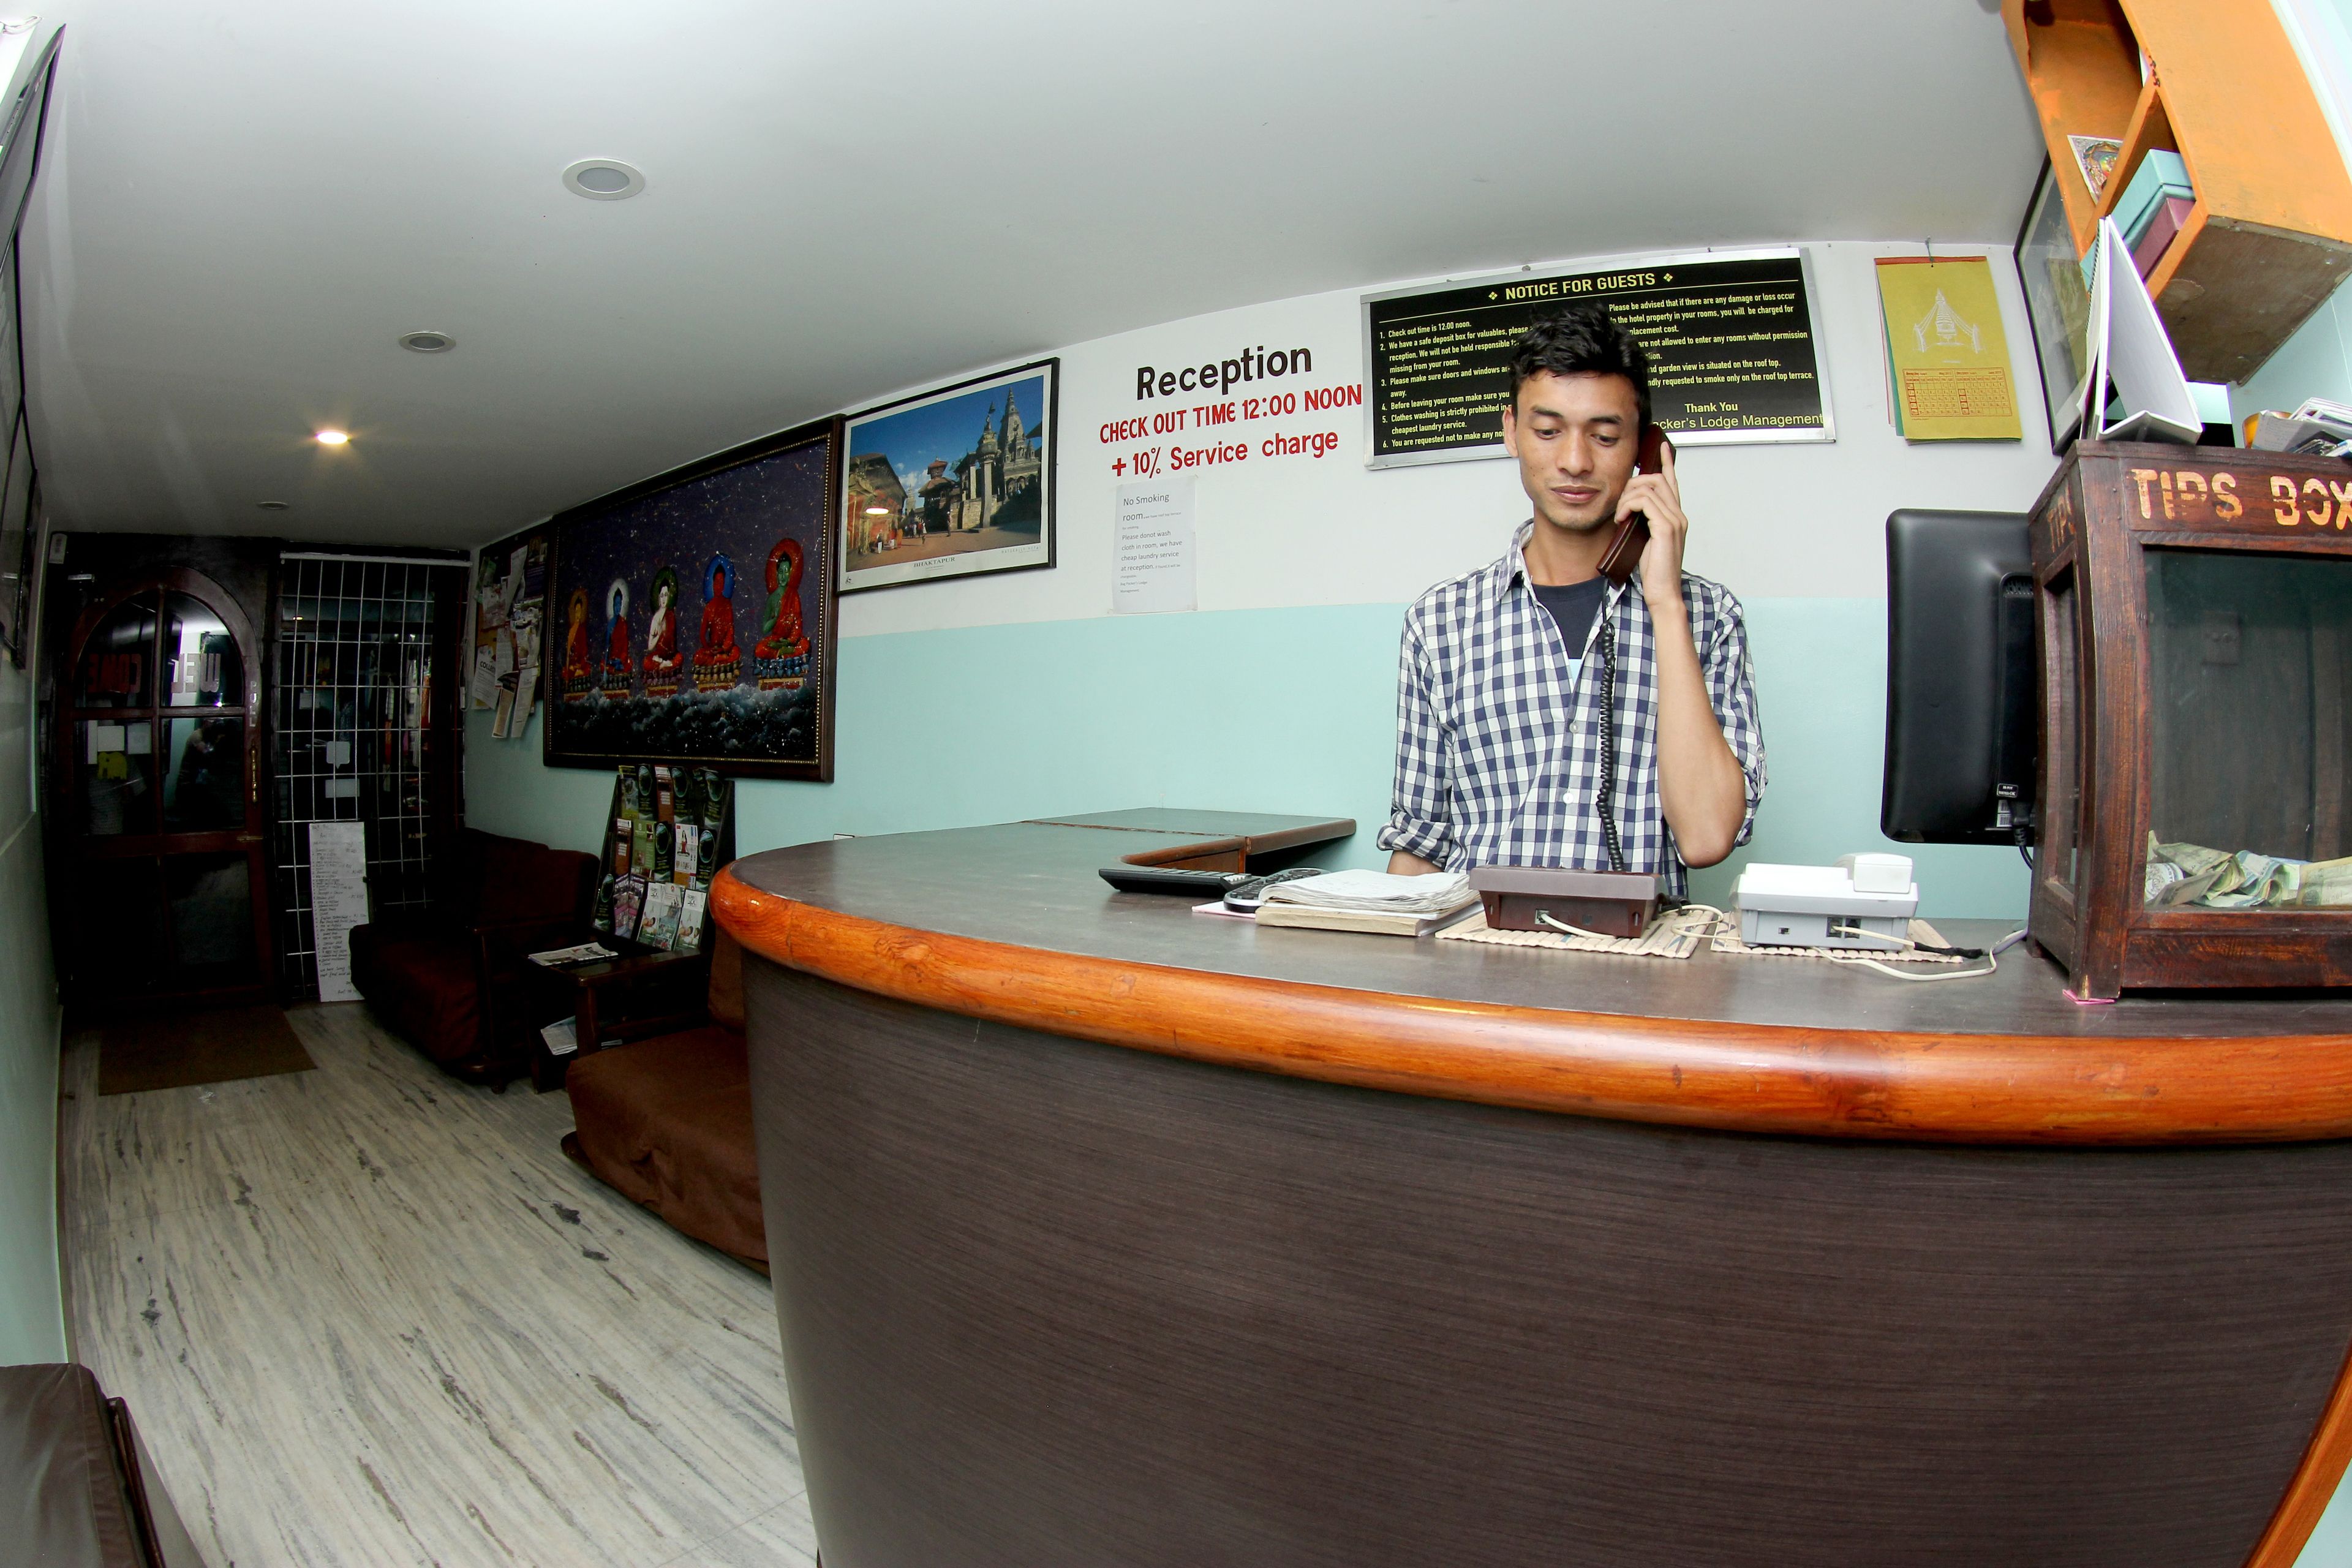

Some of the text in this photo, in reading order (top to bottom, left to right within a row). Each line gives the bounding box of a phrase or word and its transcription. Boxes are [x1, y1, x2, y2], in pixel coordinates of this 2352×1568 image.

[1506, 273, 1655, 300] NOTICE FOR GUESTS
[1641, 300, 1664, 309] advised
[1646, 313, 1672, 323] property
[1758, 305, 1783, 315] charged
[1389, 329, 1406, 337] Check
[1439, 322, 1454, 331] 12:00
[1433, 334, 1454, 344] deposit
[1509, 326, 1528, 336] please
[1628, 326, 1662, 335] placement
[1662, 337, 1686, 345] allowed
[1773, 331, 1807, 341] permission
[1390, 352, 1417, 361] reception.
[1475, 340, 1510, 351] responsible
[1137, 345, 1312, 400] Reception
[1390, 364, 1412, 373] missing
[1473, 367, 1500, 375] windows
[1659, 364, 1681, 374] garden
[1706, 361, 1732, 369] situated
[1768, 359, 1781, 368] top.
[1663, 376, 1694, 386] requested
[1727, 374, 1740, 383] only
[1777, 372, 1787, 381] top
[1434, 398, 1447, 407] your
[1684, 402, 1738, 412] Thank You
[1100, 383, 1362, 444] CHECK OUT TIME 12:00 NOON
[1414, 410, 1438, 419] washing
[1447, 407, 1467, 416] strictly
[1469, 404, 1499, 415] prohibited
[1700, 416, 1738, 429] Lodge
[1743, 413, 1823, 427] Management
[1392, 425, 1418, 435] cheapest
[1419, 423, 1442, 431] laundry
[1415, 435, 1444, 445] requested
[1133, 432, 1338, 478] 10% Service charge
[1136, 494, 1169, 504] Smoking
[2131, 469, 2352, 530] TIPS BOX
[913, 557, 956, 568] BHAKTAPUR
[249, 680, 258, 728] PULL
